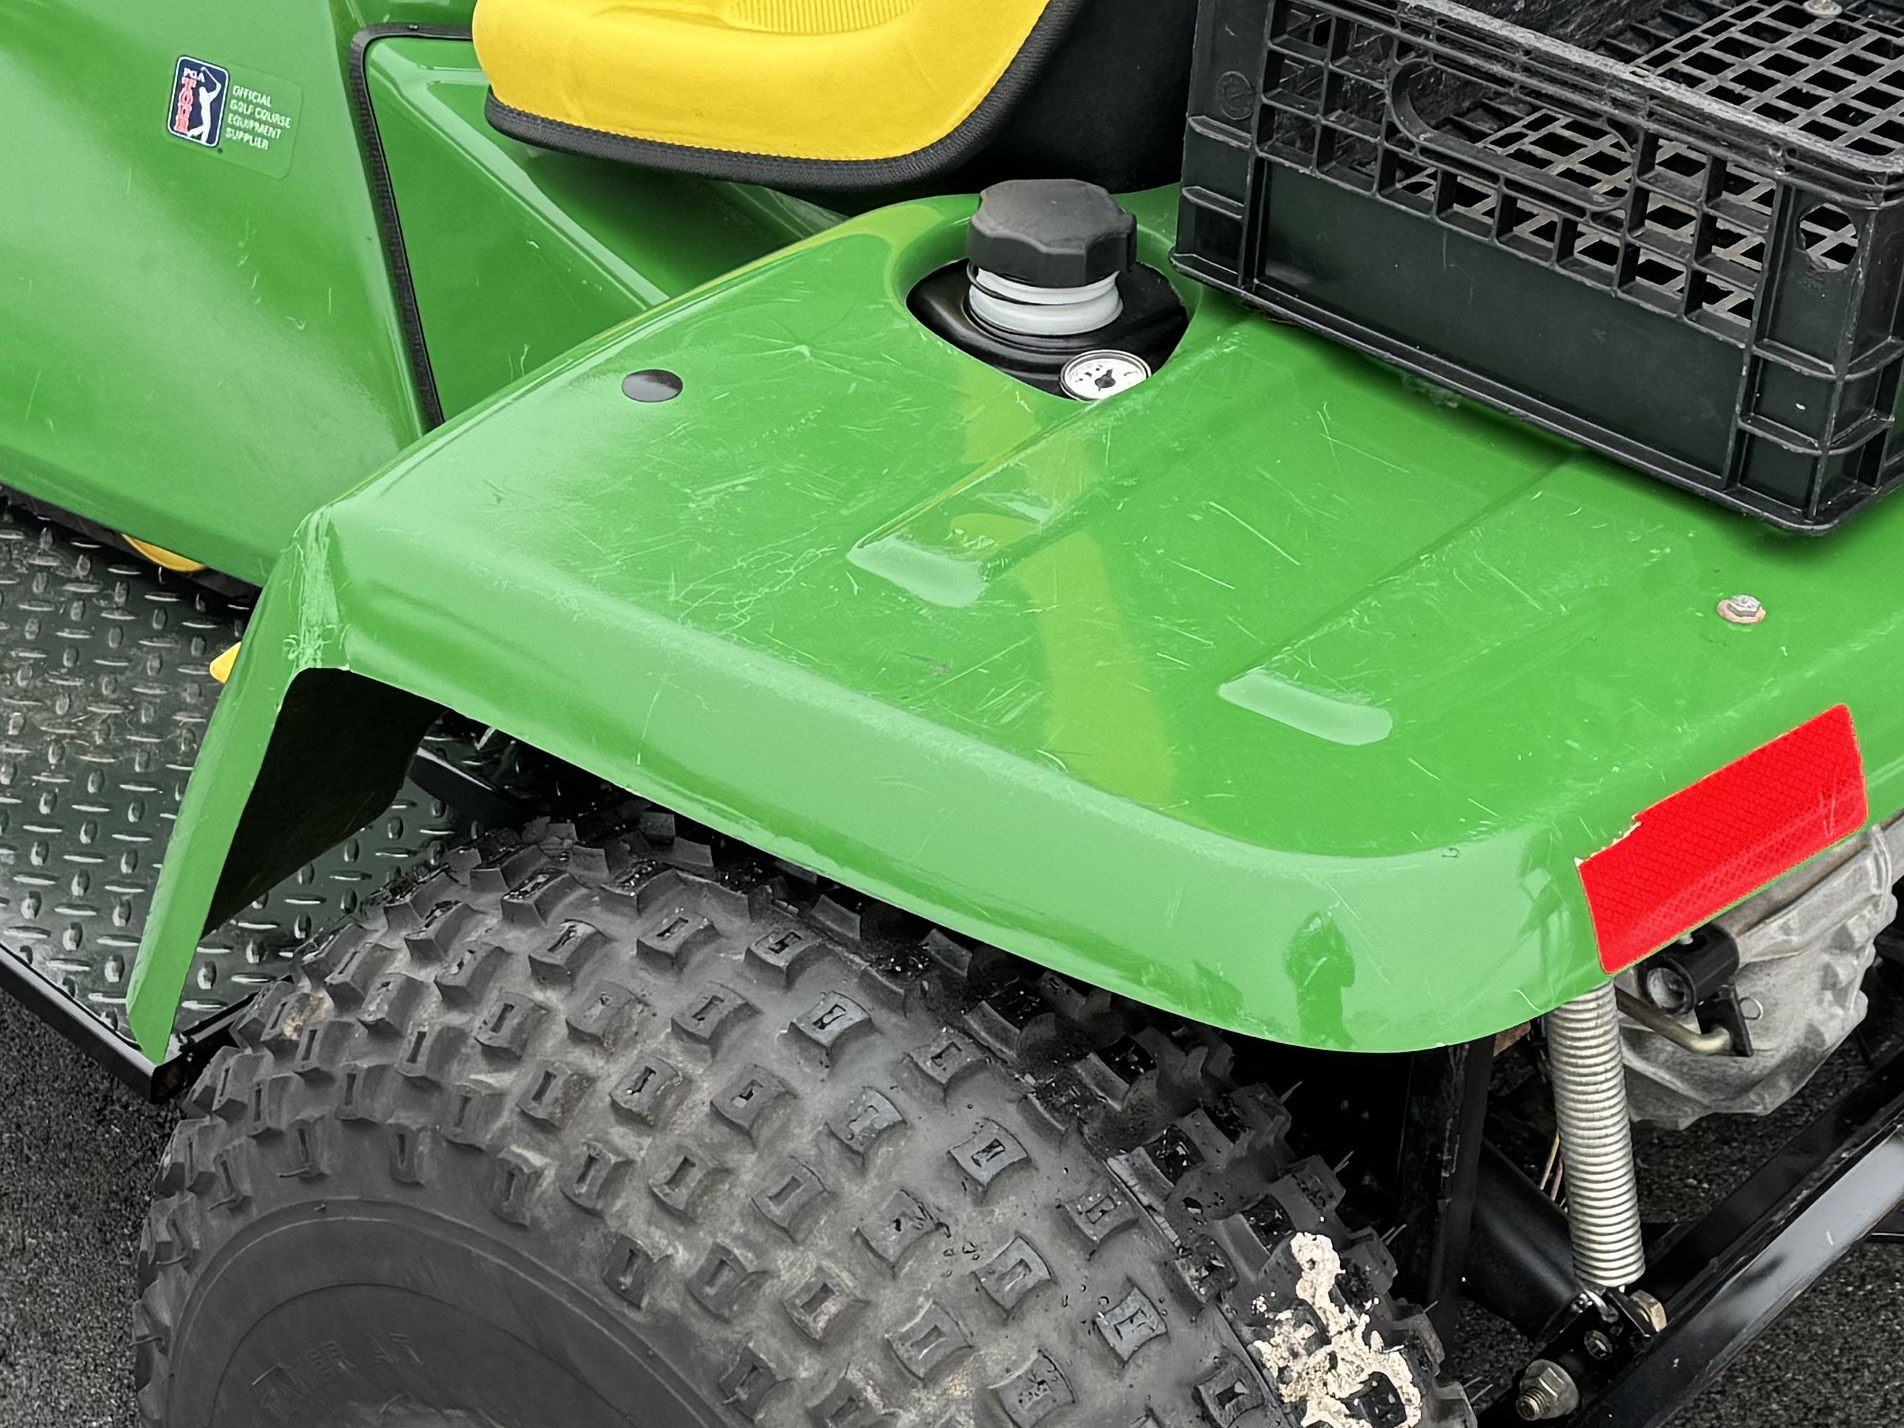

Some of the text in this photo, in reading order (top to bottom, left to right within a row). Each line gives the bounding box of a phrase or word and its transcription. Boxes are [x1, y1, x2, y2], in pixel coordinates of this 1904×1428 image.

[183, 67, 205, 83] PGA
[173, 76, 197, 136] TOUR
[232, 85, 272, 108] OFFICIAL
[227, 113, 281, 139] EQUIPMENT
[229, 99, 292, 129] GOLF COURSE
[225, 127, 269, 150] SUPPLIER
